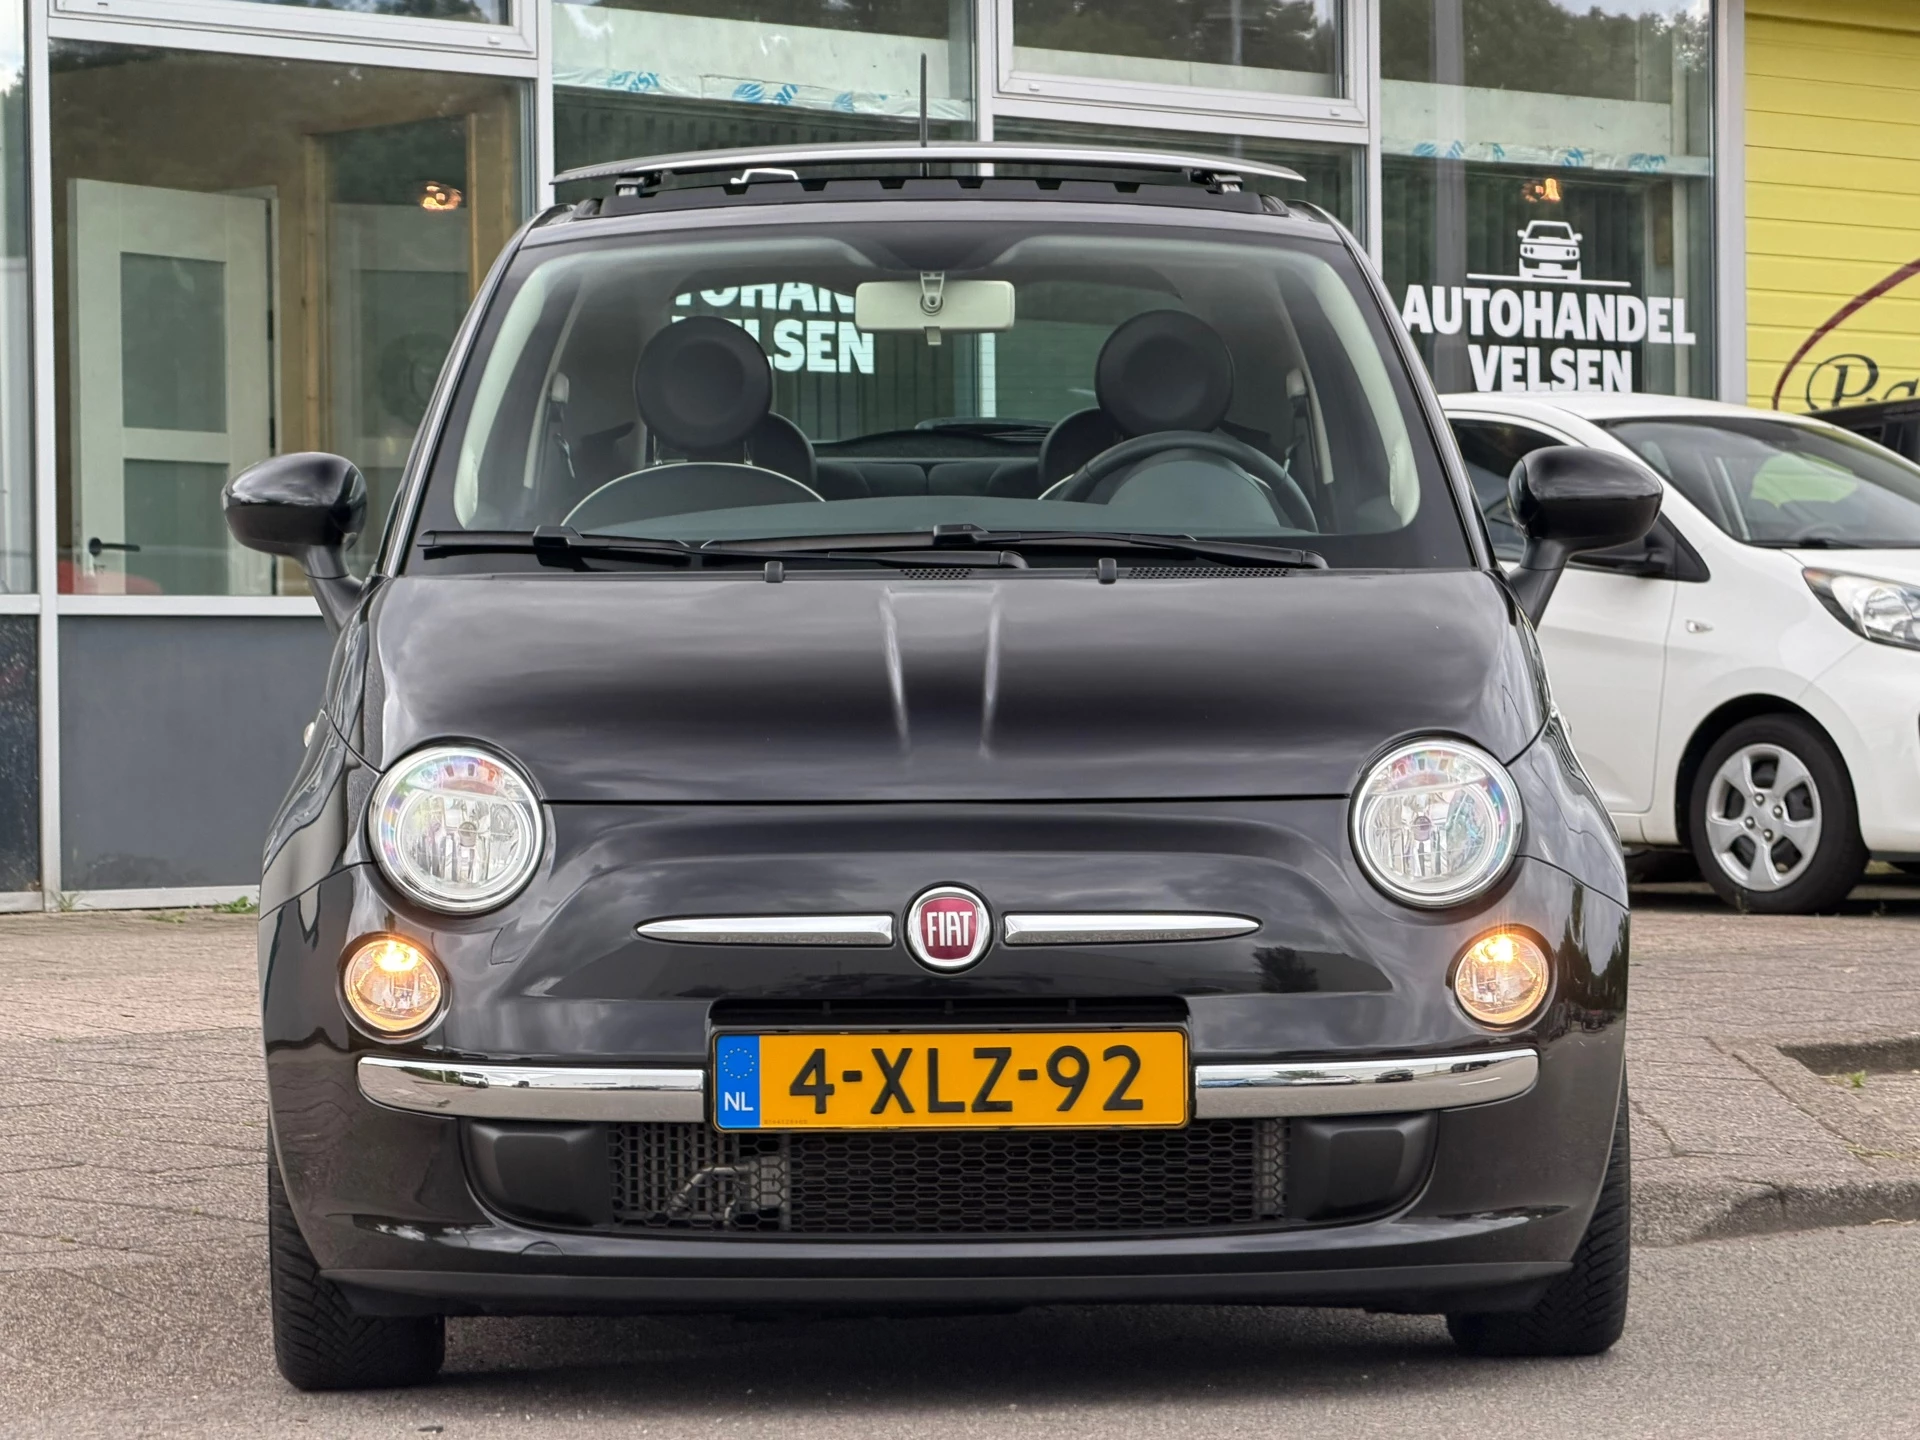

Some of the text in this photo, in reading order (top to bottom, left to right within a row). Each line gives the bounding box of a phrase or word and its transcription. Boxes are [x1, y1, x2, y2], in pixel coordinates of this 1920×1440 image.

[1401, 284, 1697, 345] AUTOHANDEL
[1467, 344, 1633, 393] VELSEN
[926, 911, 973, 947] FIAT
[723, 1092, 755, 1112] NL
[789, 1045, 1144, 1115] 4-XLZ-92
